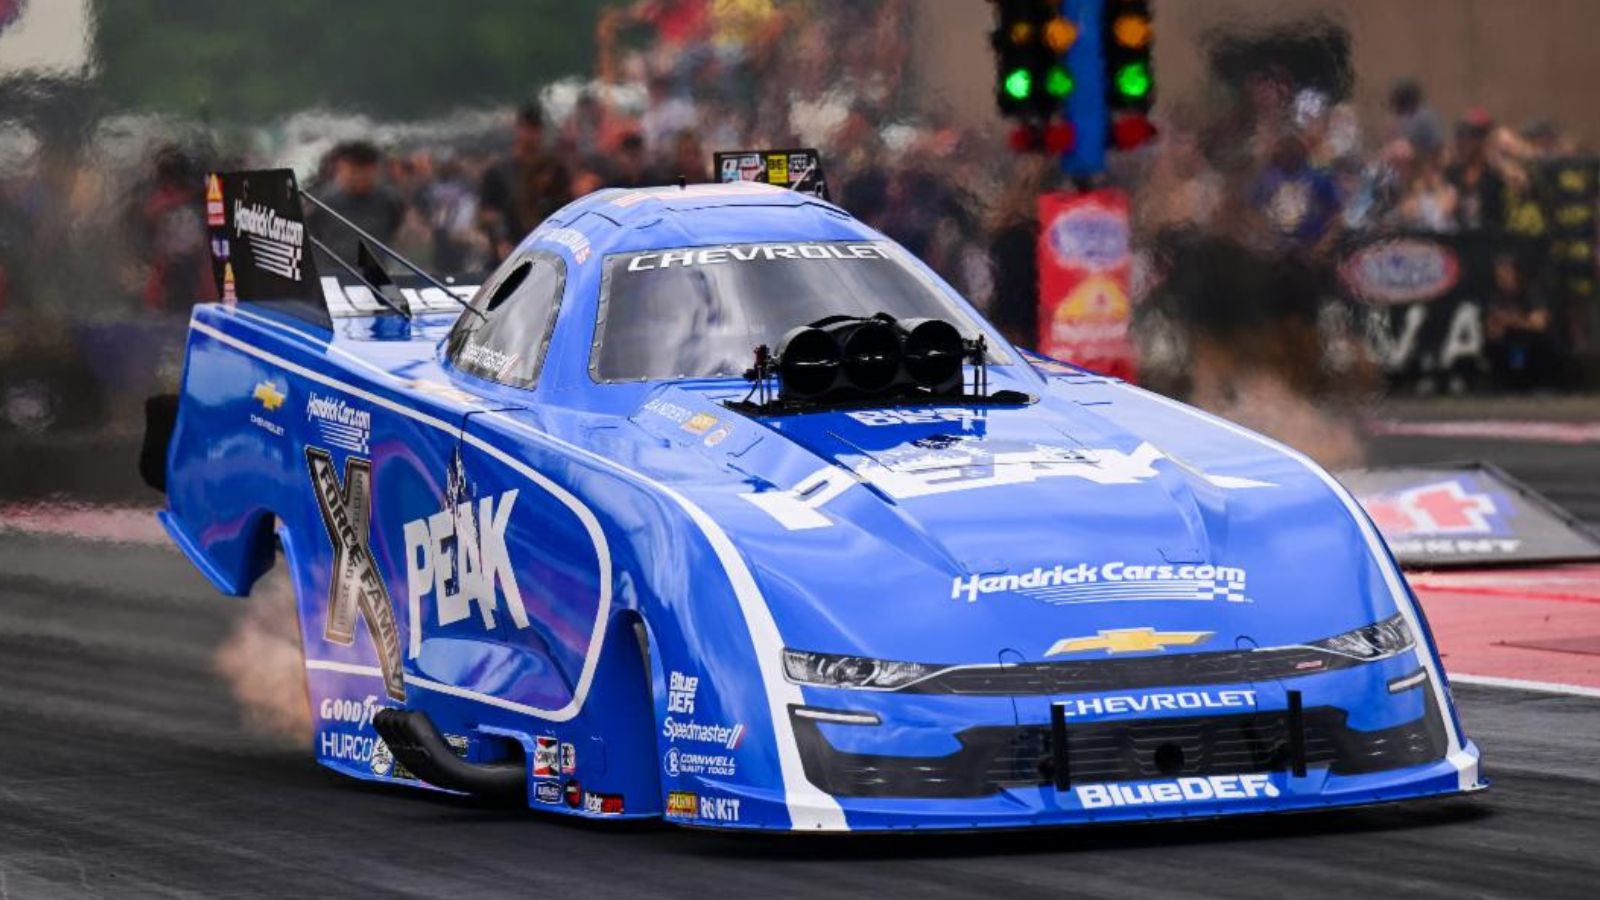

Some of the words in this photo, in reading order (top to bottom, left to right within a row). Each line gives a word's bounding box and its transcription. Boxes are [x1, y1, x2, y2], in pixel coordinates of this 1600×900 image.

[628, 243, 889, 272] CHEVROLET
[318, 466, 365, 568] FORCE
[359, 568, 404, 684] FAMILY
[403, 488, 531, 660] PEAK
[670, 671, 698, 692] Blue
[1052, 690, 1256, 717] CHEVROLET
[663, 716, 732, 743] Speedmaster
[321, 731, 373, 761] HURCO
[680, 753, 736, 767] CORNWELL
[708, 766, 736, 776] TOOLS
[1075, 774, 1280, 809] BlueDEF
